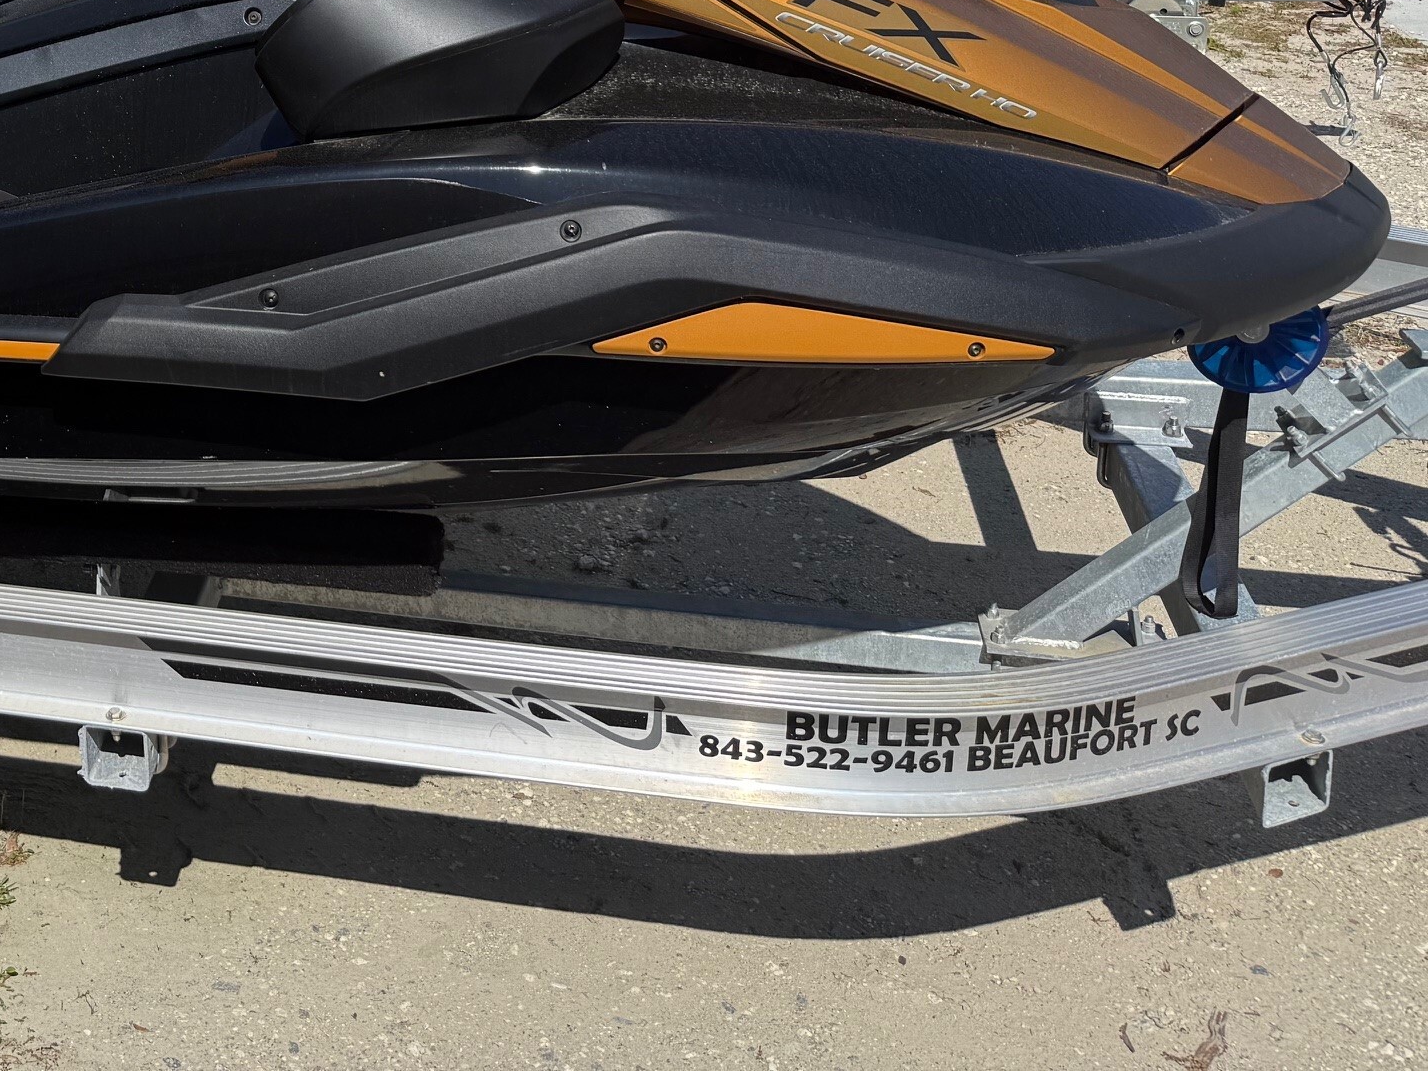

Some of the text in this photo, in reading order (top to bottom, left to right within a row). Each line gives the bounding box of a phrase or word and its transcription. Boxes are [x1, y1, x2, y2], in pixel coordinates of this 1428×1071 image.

[775, 11, 1038, 120] CRUISER HO
[698, 709, 1202, 773] 843-522-9461 BEAUFORT SC
[785, 695, 1136, 747] BUTLER MARINE
